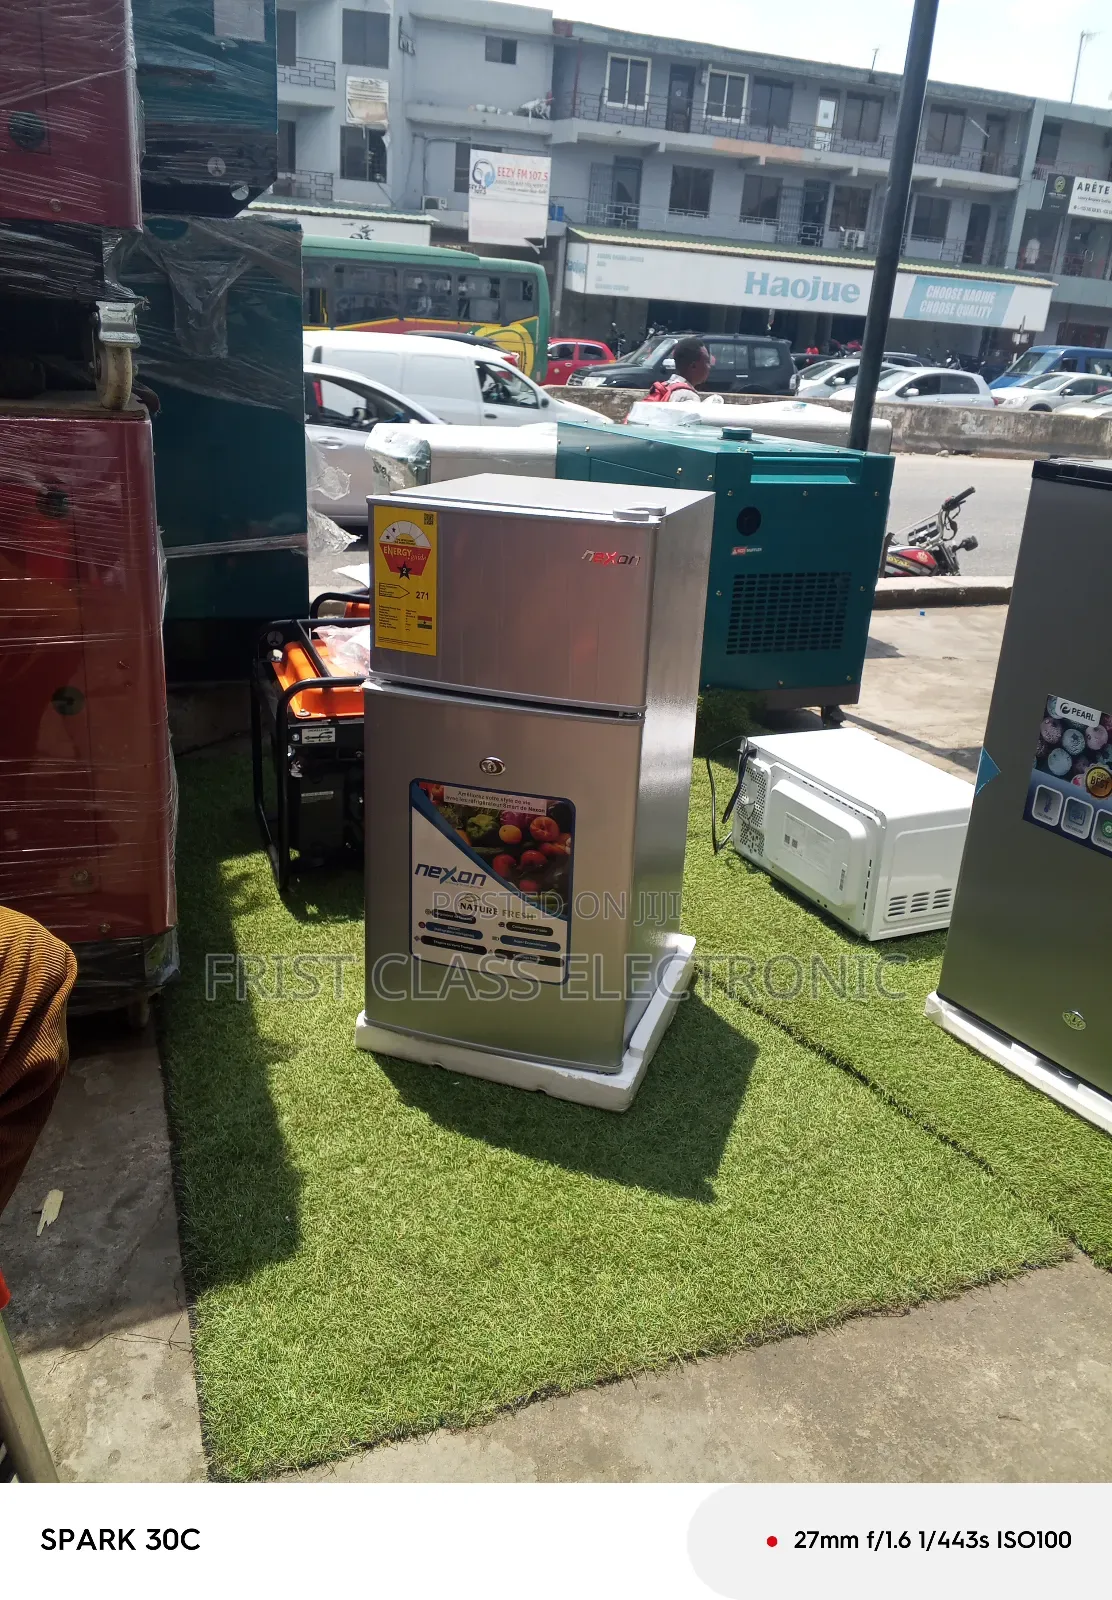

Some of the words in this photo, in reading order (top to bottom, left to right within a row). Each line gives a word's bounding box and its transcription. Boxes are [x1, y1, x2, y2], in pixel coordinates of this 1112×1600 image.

[497, 166, 515, 178] EEZY
[517, 168, 528, 179] FM
[528, 171, 549, 181] 107.5
[1077, 181, 1110, 195] ARÊTE
[744, 271, 861, 304] Haojue
[926, 285, 963, 301] CHOOSE
[920, 300, 957, 316] CHOOSE
[956, 303, 993, 319] QUALITY
[383, 545, 412, 557] ENERGY
[581, 549, 641, 567] nexon
[415, 591, 429, 600] 271
[1071, 707, 1096, 722] PEARL
[415, 863, 487, 887] nexon
[459, 902, 498, 916] NATURE
[501, 909, 534, 920] FRESH
